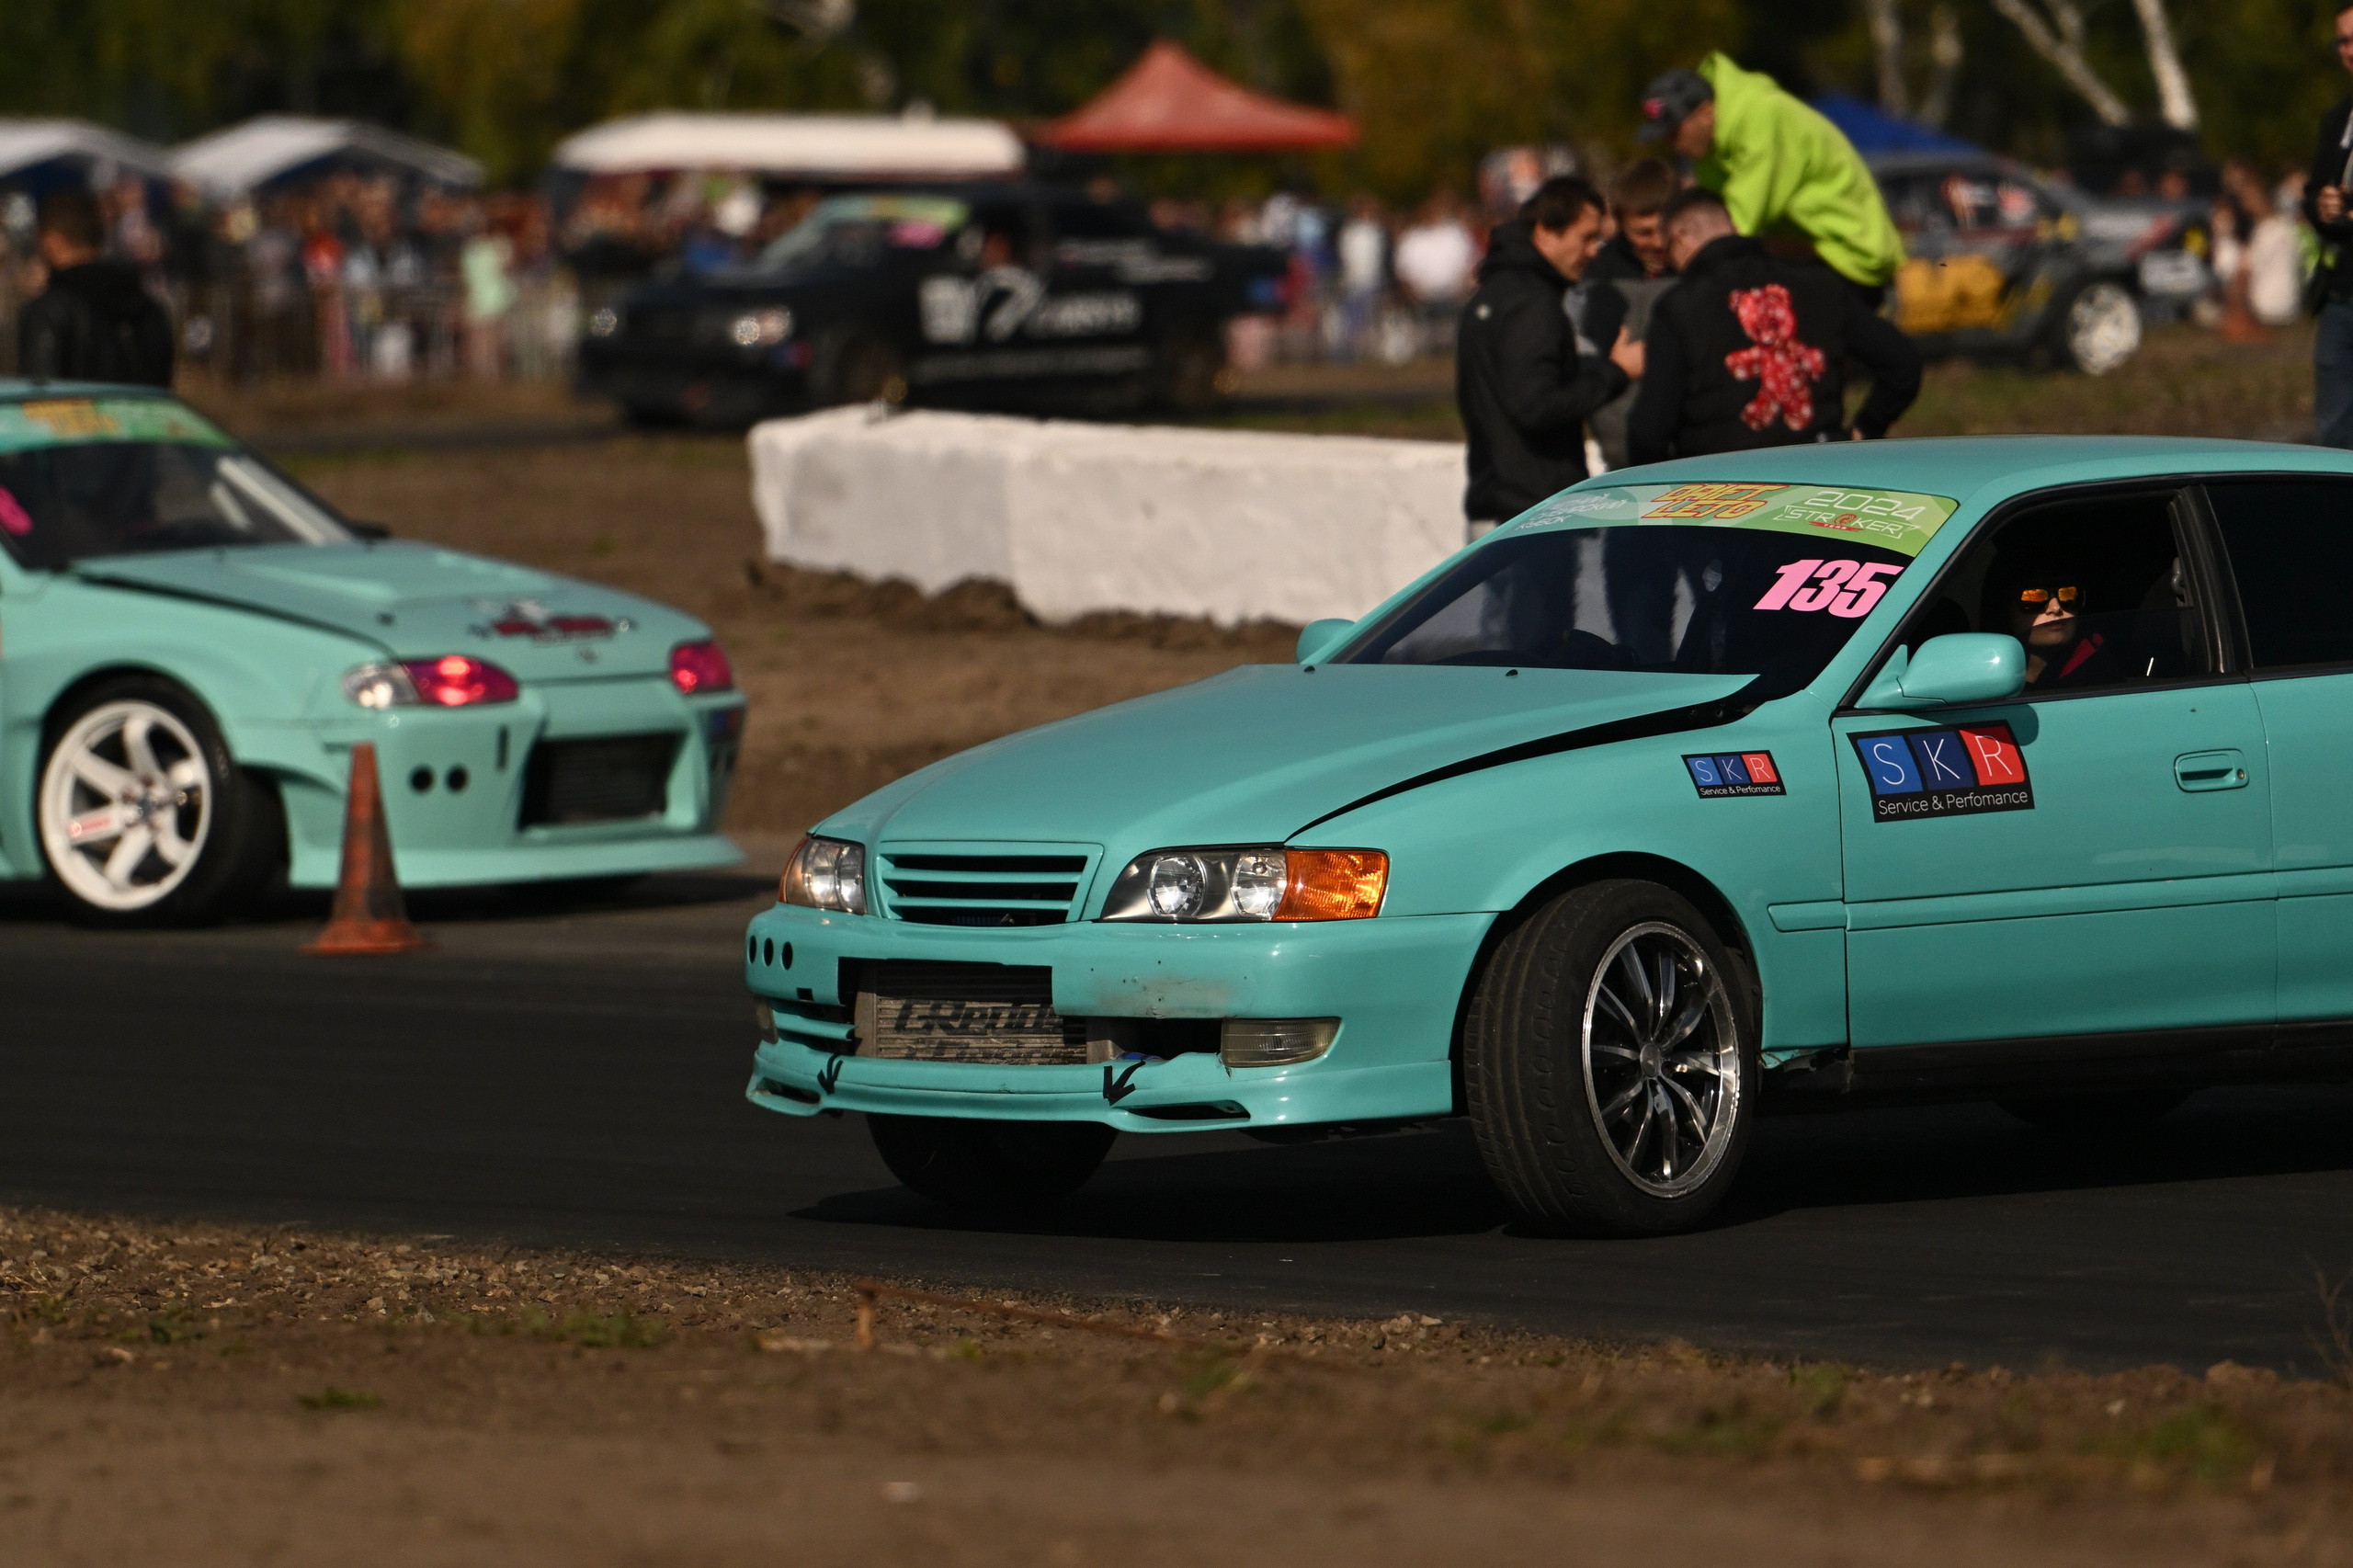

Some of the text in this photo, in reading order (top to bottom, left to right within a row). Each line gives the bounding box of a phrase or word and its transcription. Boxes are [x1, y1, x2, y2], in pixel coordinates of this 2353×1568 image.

[1651, 483, 1790, 502] DRIFT
[1641, 500, 1768, 519] LETO
[1804, 490, 1926, 521] 2024
[1753, 559, 1905, 619] 135
[1694, 757, 1771, 782] SKR
[1873, 735, 2013, 786] SKR
[1699, 785, 1781, 796] Service & Perfomance
[1878, 791, 2029, 815] Service & Perfomance
